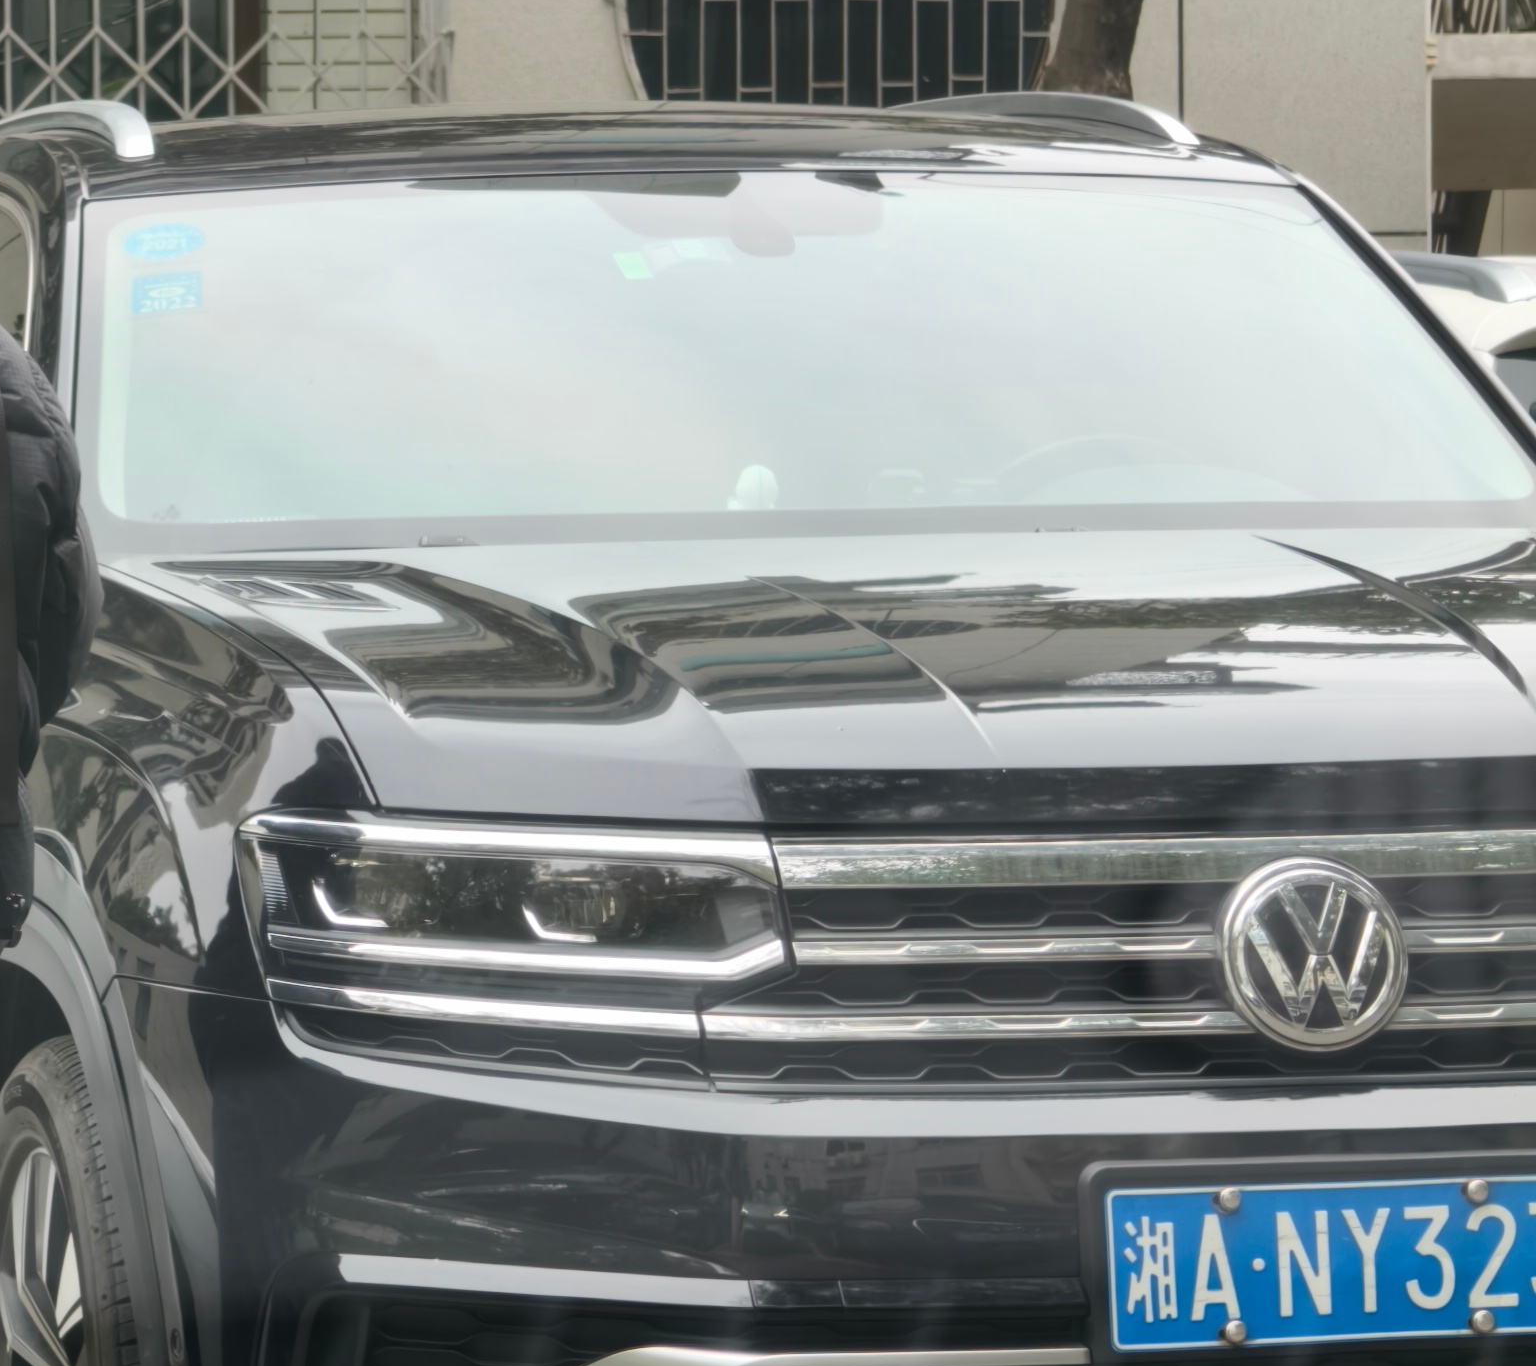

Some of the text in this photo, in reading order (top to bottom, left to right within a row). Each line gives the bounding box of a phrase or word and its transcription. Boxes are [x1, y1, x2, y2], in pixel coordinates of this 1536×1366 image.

[142, 236, 187, 252] 2021
[139, 294, 197, 314] 2022
[1123, 1202, 1536, 1324] 湘A·NY32
